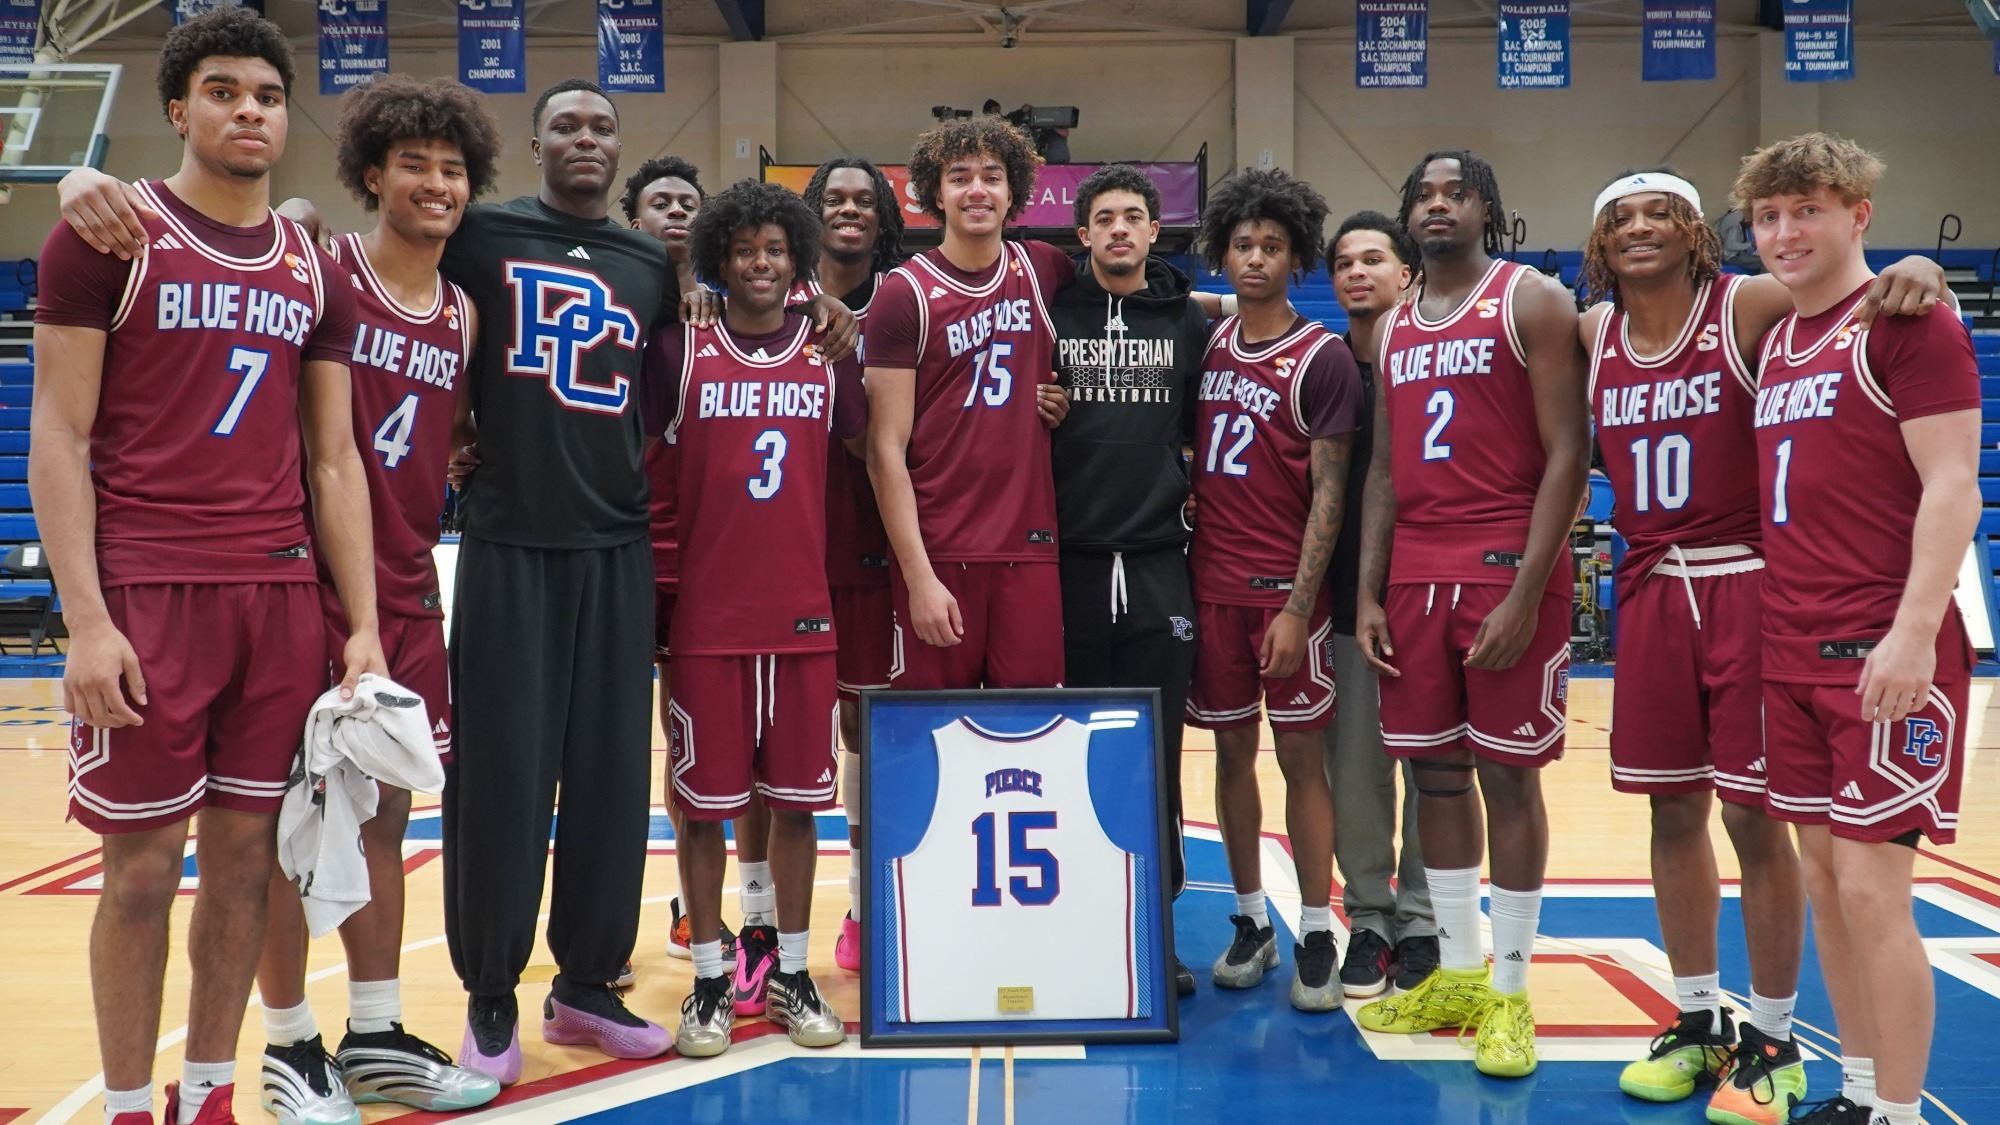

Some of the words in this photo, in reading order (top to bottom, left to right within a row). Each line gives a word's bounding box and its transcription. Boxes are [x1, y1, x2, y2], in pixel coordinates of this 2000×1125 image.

[1360, 3, 1426, 11] VOLLEYBALL
[1501, 5, 1567, 14] VOLLEYBALL
[1675, 10, 1712, 19] BASKETBALL
[1812, 15, 1850, 23] BASKETBALL
[1380, 16, 1406, 26] 2004
[1520, 19, 1547, 29] 2005
[322, 26, 384, 34] VOLLEYBALL
[1654, 30, 1672, 38] 1994
[1825, 31, 1837, 39] SAC
[620, 33, 641, 43] 2003
[481, 39, 501, 49] 2001
[1359, 41, 1376, 50] S.A.C.
[1378, 40, 1426, 50] CO-CHAMPIONS
[1524, 40, 1562, 51] CHAMPIONS
[1652, 39, 1706, 49] TOURNAMENT
[1795, 41, 1838, 50] TOURNAMENT
[1361, 52, 1379, 62] S.A.C.
[1380, 52, 1424, 62] TOURNAMENT
[1521, 52, 1564, 62] TOURNAMENT
[1797, 51, 1835, 60] CHAMPIONS
[322, 59, 336, 69] SAC
[341, 59, 386, 69] TOURNAMENT
[484, 57, 499, 67] SAC
[620, 62, 642, 72] S.A.C.
[1374, 62, 1412, 72] CHAMPIONS
[1785, 62, 1801, 71] NCAA
[1805, 61, 1849, 70] TOURNAMENT
[1514, 62, 1552, 73] CHAMPIONS
[468, 69, 516, 79] CHAMPIONS
[608, 75, 655, 84] CHAMPIONS
[1361, 76, 1379, 85] NCAA
[1380, 75, 1423, 85] TOURNAMENT
[1501, 76, 1520, 85] NCAA
[1521, 75, 1564, 85] TOURNAMENT
[157, 282, 241, 331] BLUE
[244, 287, 314, 347] HOSE
[946, 307, 992, 358] BLUE
[993, 298, 1032, 333] HOSE
[503, 257, 641, 417] PC
[351, 322, 406, 374] LUE
[405, 338, 460, 391] HOSE
[1059, 339, 1174, 366] PRESBYTERIAN
[1390, 343, 1434, 388] BLUE
[1435, 338, 1496, 377] HOSE
[963, 341, 1014, 408] 15
[211, 344, 272, 438] 7
[1198, 370, 1236, 401] BLUE
[1233, 375, 1281, 422] HOSE
[699, 381, 762, 419] BLUE
[766, 381, 826, 420] HOSE
[1602, 383, 1650, 427] BLUE
[1652, 371, 1721, 422] HOSE
[1754, 381, 1791, 428] BLUE
[1784, 371, 1843, 423] HOSE
[1423, 388, 1455, 462] 2
[372, 391, 421, 470] 4
[1206, 412, 1255, 476] 12
[747, 428, 789, 500] 3
[1630, 432, 1693, 513] 10
[1772, 436, 1793, 526] 1
[1903, 717, 1943, 766] PC
[985, 768, 1042, 799] PIERCE
[972, 811, 1060, 907] 15
